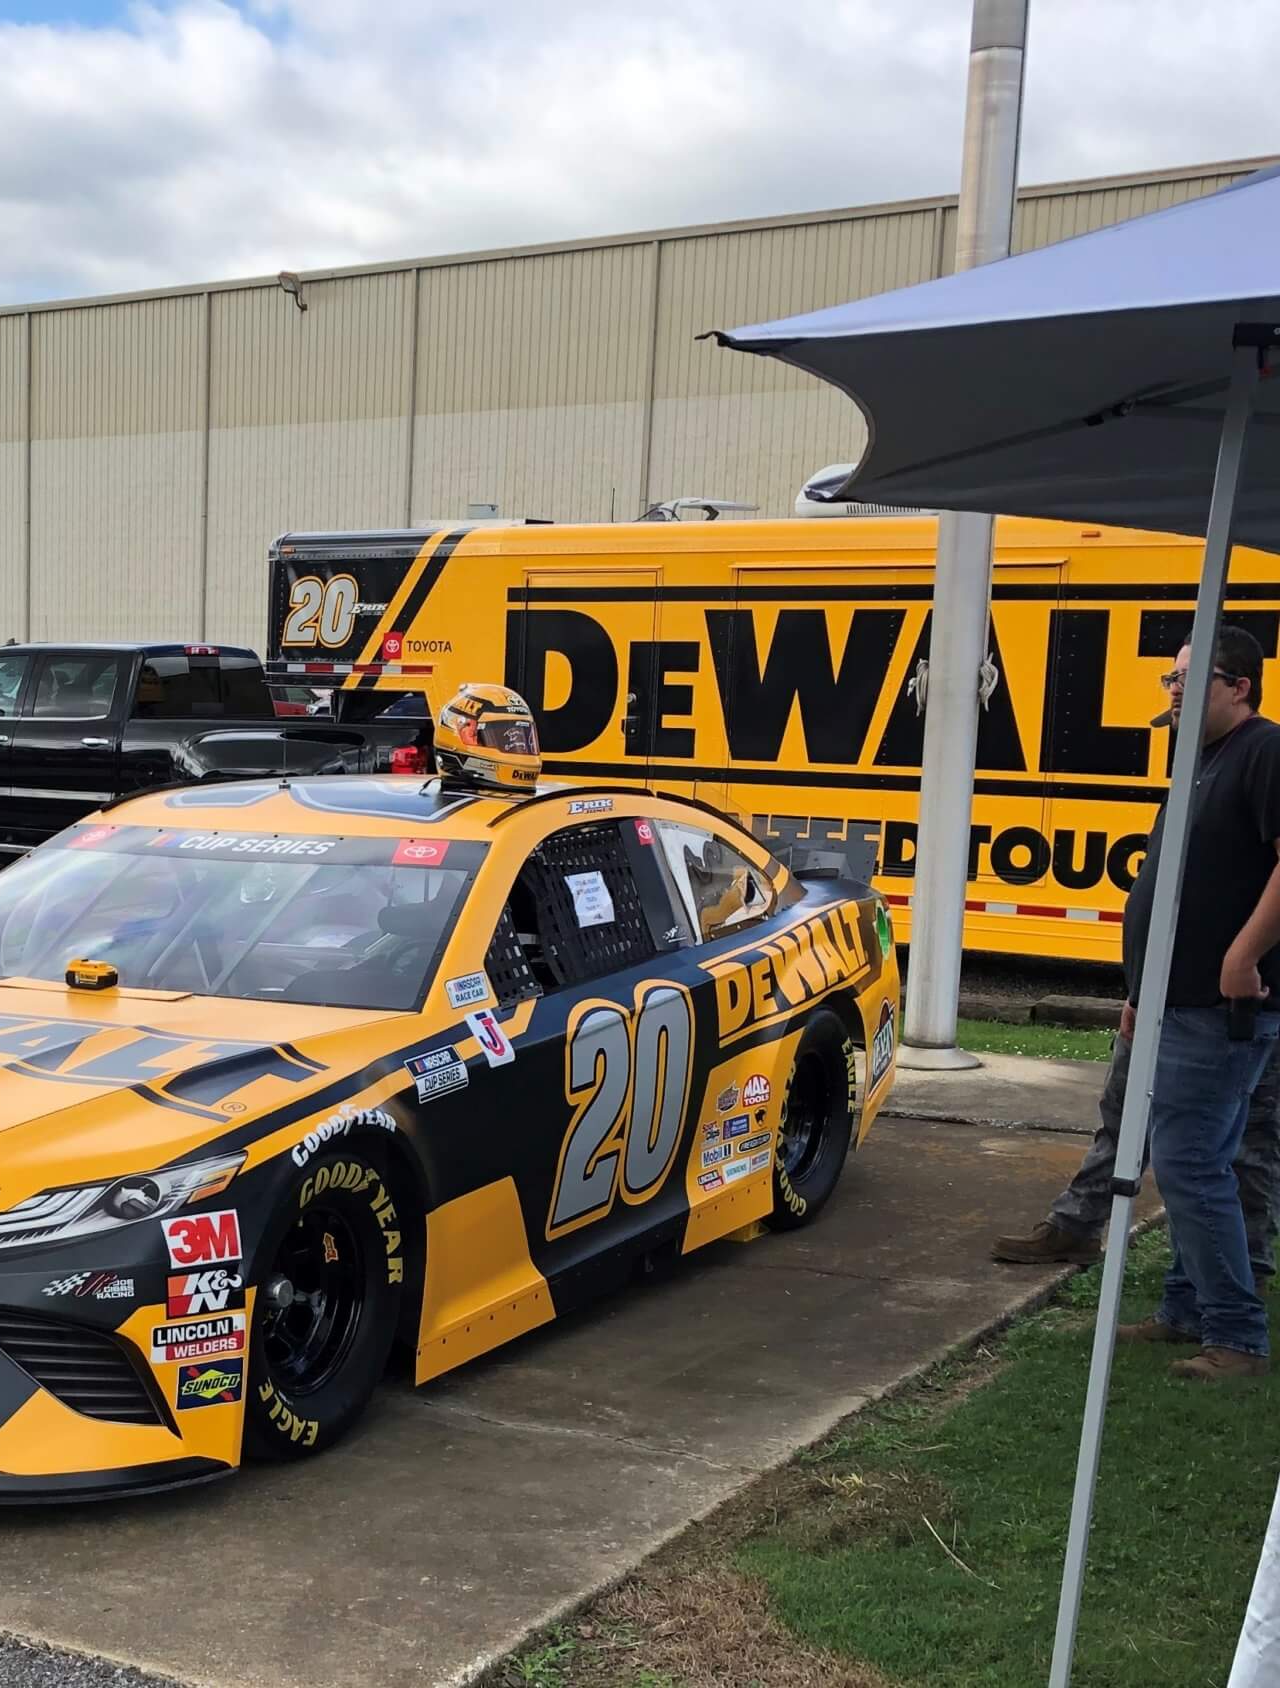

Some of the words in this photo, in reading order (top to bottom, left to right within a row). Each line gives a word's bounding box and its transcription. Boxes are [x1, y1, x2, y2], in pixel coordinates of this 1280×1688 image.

[282, 574, 359, 649] 20
[407, 640, 452, 652] TOYOTA
[179, 835, 238, 850] CUP
[232, 838, 336, 855] SERIES
[707, 901, 867, 1036] DEWALT
[455, 990, 473, 1003] RACE
[471, 987, 484, 999] CAR
[424, 1074, 438, 1091] CUP
[437, 1067, 461, 1087] SERIES
[744, 1076, 770, 1099] MAC
[546, 979, 696, 1241] 20
[744, 1094, 769, 1106] TOOLS
[291, 1104, 397, 1168] GOODYEAR
[299, 1161, 403, 1285] GOODYEAR
[169, 1213, 240, 1265] 3M
[157, 1319, 230, 1345] LINCOLN
[173, 1337, 238, 1359] WELDERS
[183, 1374, 241, 1395] SUNOCO
[258, 1376, 319, 1446] EAGLE
